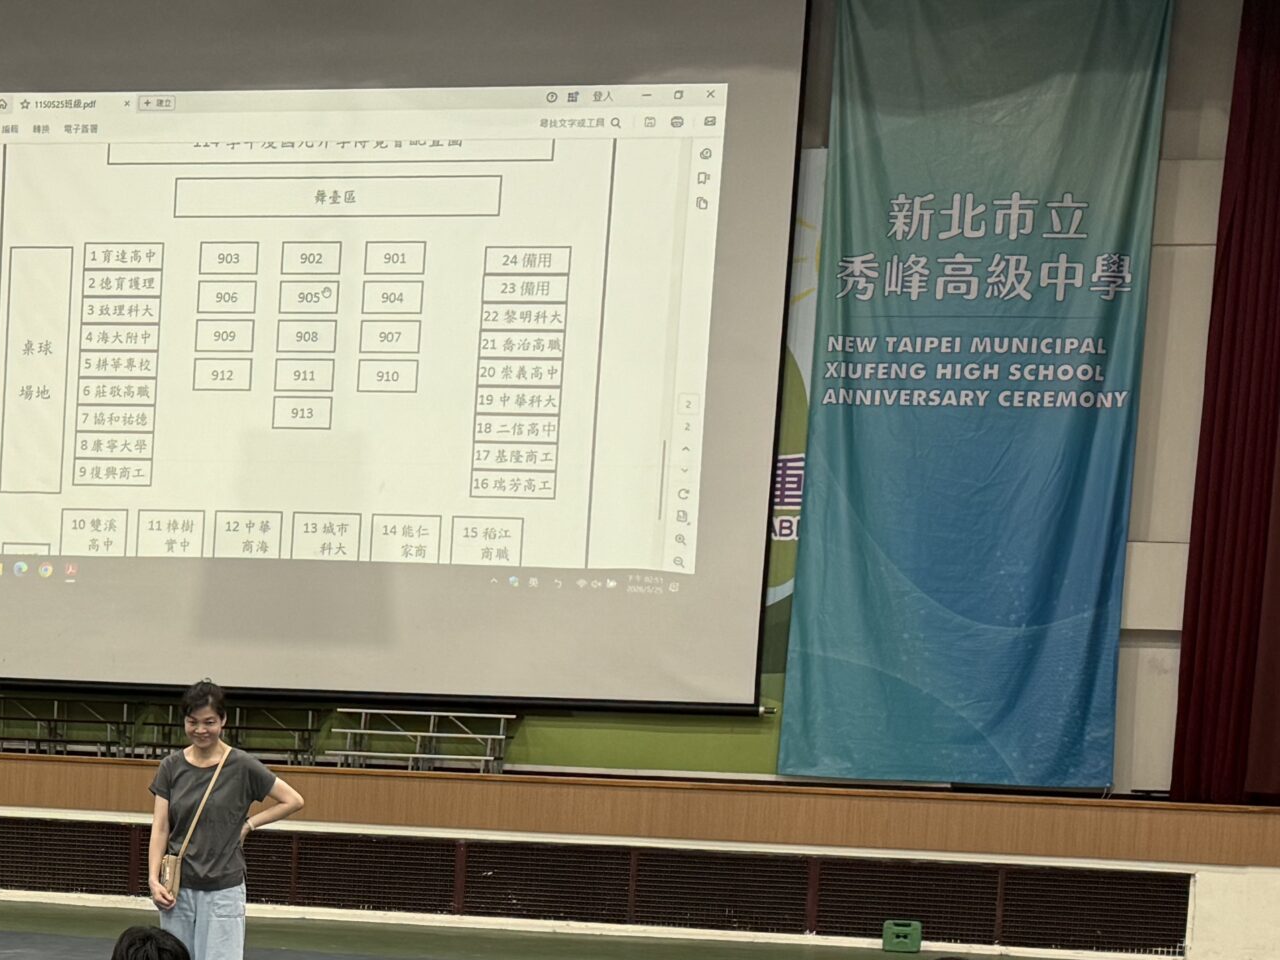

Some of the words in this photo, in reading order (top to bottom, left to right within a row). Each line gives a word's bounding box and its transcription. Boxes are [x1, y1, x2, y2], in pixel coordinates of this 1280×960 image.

[886, 191, 1090, 241] 新北市立
[90, 250, 97, 262] 1
[102, 249, 156, 263] 育達高中
[217, 252, 240, 265] 903
[300, 252, 323, 265] 902
[383, 252, 407, 265] 901
[501, 254, 519, 267] 24
[523, 253, 552, 268] 備用
[88, 277, 96, 289] 2
[99, 277, 154, 291] 德育護理
[835, 252, 1133, 302] 秀峰高級中學
[500, 282, 517, 295] 23
[521, 281, 550, 296] 備用
[215, 291, 239, 304] 906
[298, 292, 320, 304] 905
[381, 291, 404, 304] 904
[87, 304, 95, 316] 3
[98, 304, 154, 317] 致理科大
[483, 310, 499, 323] 22
[504, 309, 562, 324] 黎明科大
[84, 332, 93, 343] 4
[97, 330, 150, 344] 海大附中
[213, 330, 237, 342] 909
[295, 330, 319, 343] 908
[378, 331, 402, 343] 907
[22, 340, 52, 355] 桌球
[481, 338, 497, 351] 21
[503, 337, 561, 352] 喬治高職
[826, 335, 878, 354] NEW
[885, 336, 962, 354] TAIPEI
[969, 336, 1107, 355] MUNICIPAL
[84, 357, 92, 370] 5
[211, 369, 234, 382] 912
[293, 369, 316, 382] 911
[376, 370, 400, 383] 910
[479, 366, 496, 378] 20
[824, 362, 926, 380] XIUFENG
[935, 363, 1000, 381] HIGH
[1007, 363, 1105, 382] SCHOOL
[19, 385, 50, 400] 場地
[82, 385, 91, 397] 6
[95, 384, 150, 399] 莊敬高職
[478, 393, 494, 406] 19
[500, 393, 556, 408] 中華科大
[685, 400, 692, 409] 2
[822, 389, 990, 407] ANNIVERSARY
[997, 390, 1131, 409] CEREMONY
[81, 412, 90, 425] 7
[290, 407, 314, 420] 913
[476, 422, 493, 434] 18
[496, 422, 555, 437] 二信高中
[80, 439, 89, 451] 8
[91, 439, 147, 453] 康寧大學
[475, 449, 491, 462] 17
[496, 449, 553, 464] 基隆商工
[78, 466, 87, 478] 9
[90, 466, 144, 480] 復興商工
[473, 477, 489, 490] 16
[493, 477, 552, 492] 瑞芳高工
[71, 518, 86, 531] 10
[90, 518, 117, 532] 雙溪
[147, 519, 163, 532] 11
[225, 520, 240, 533] 12
[246, 520, 271, 534] 中華
[303, 522, 318, 534] 13
[323, 522, 349, 536] 城市
[382, 524, 397, 536] 14
[402, 525, 429, 538] 能仁
[462, 526, 479, 539] 15
[483, 528, 511, 540] 稻江
[89, 538, 113, 552] 高中
[165, 538, 189, 552] 實中
[242, 540, 269, 554] 商海
[320, 542, 346, 555] 科大
[401, 544, 427, 558] 家商
[481, 546, 509, 561] 商職
